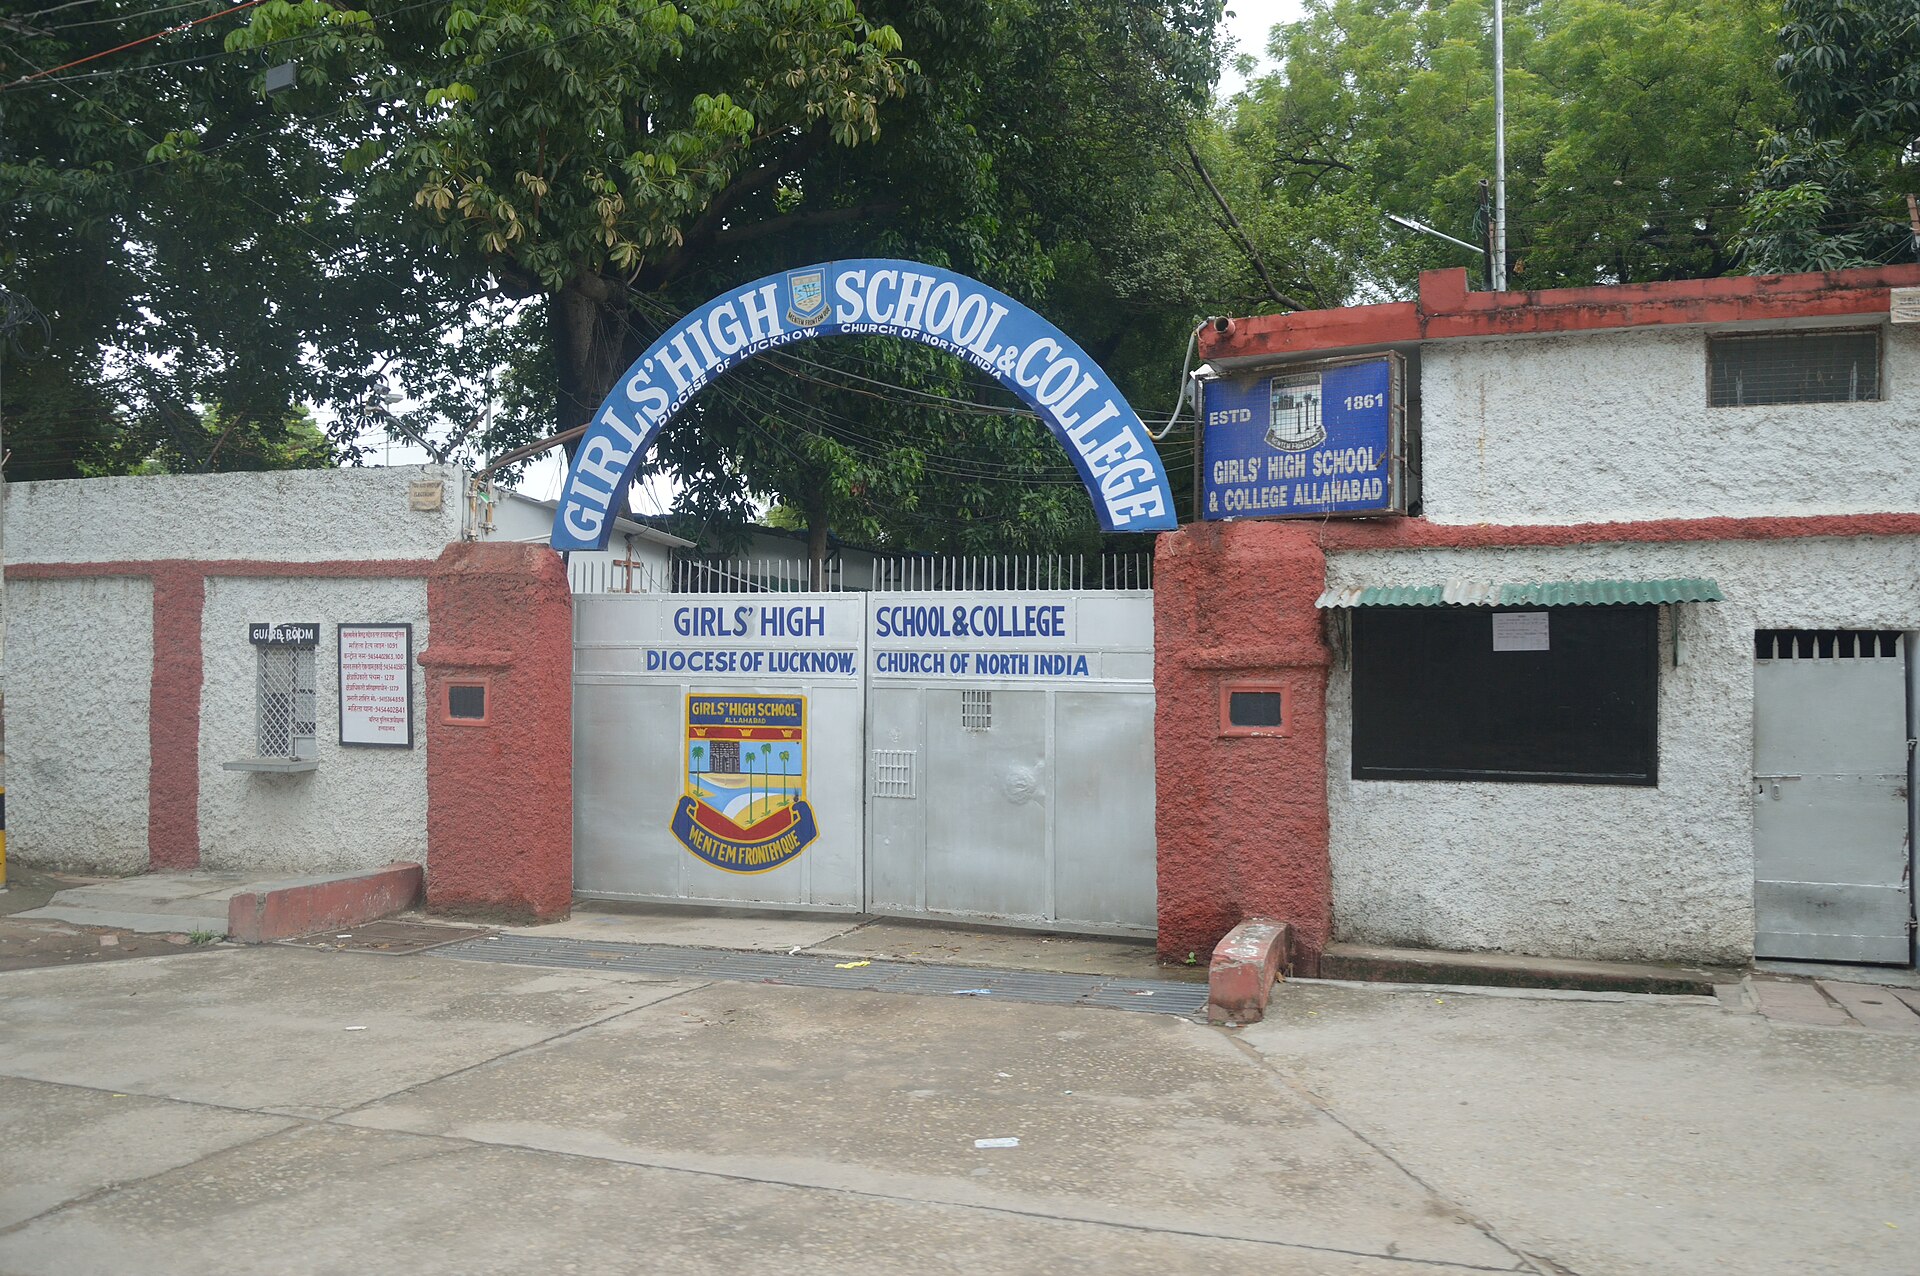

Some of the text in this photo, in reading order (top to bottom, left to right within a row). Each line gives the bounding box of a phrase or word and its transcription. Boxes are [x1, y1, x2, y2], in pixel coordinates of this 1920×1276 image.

[840, 323, 1002, 380] CHURCH OF NORTH INDIA
[657, 327, 819, 428] DIOCESE OF LUCKNOW,
[564, 283, 784, 541] GIRLS' HIGH
[836, 269, 1166, 526] SCHOOL & COLLEGE
[1344, 393, 1384, 411] 1861
[1209, 408, 1251, 426] ESTD
[1213, 446, 1377, 485] GIRLS' HIGH SCHOOL
[1209, 478, 1383, 512] & COLLEGE ALLAHABAD
[286, 629, 313, 640] ROOM
[674, 605, 1065, 637] GIRLS' HIGH SCHOOL & COLLEGE
[647, 650, 1089, 676] DIOCESE OF LUCKNOW, CHURCH OF NORTH INDIA
[692, 702, 797, 717] GIRLS' HIGH SCHOOL
[688, 825, 736, 864] MENTEM
